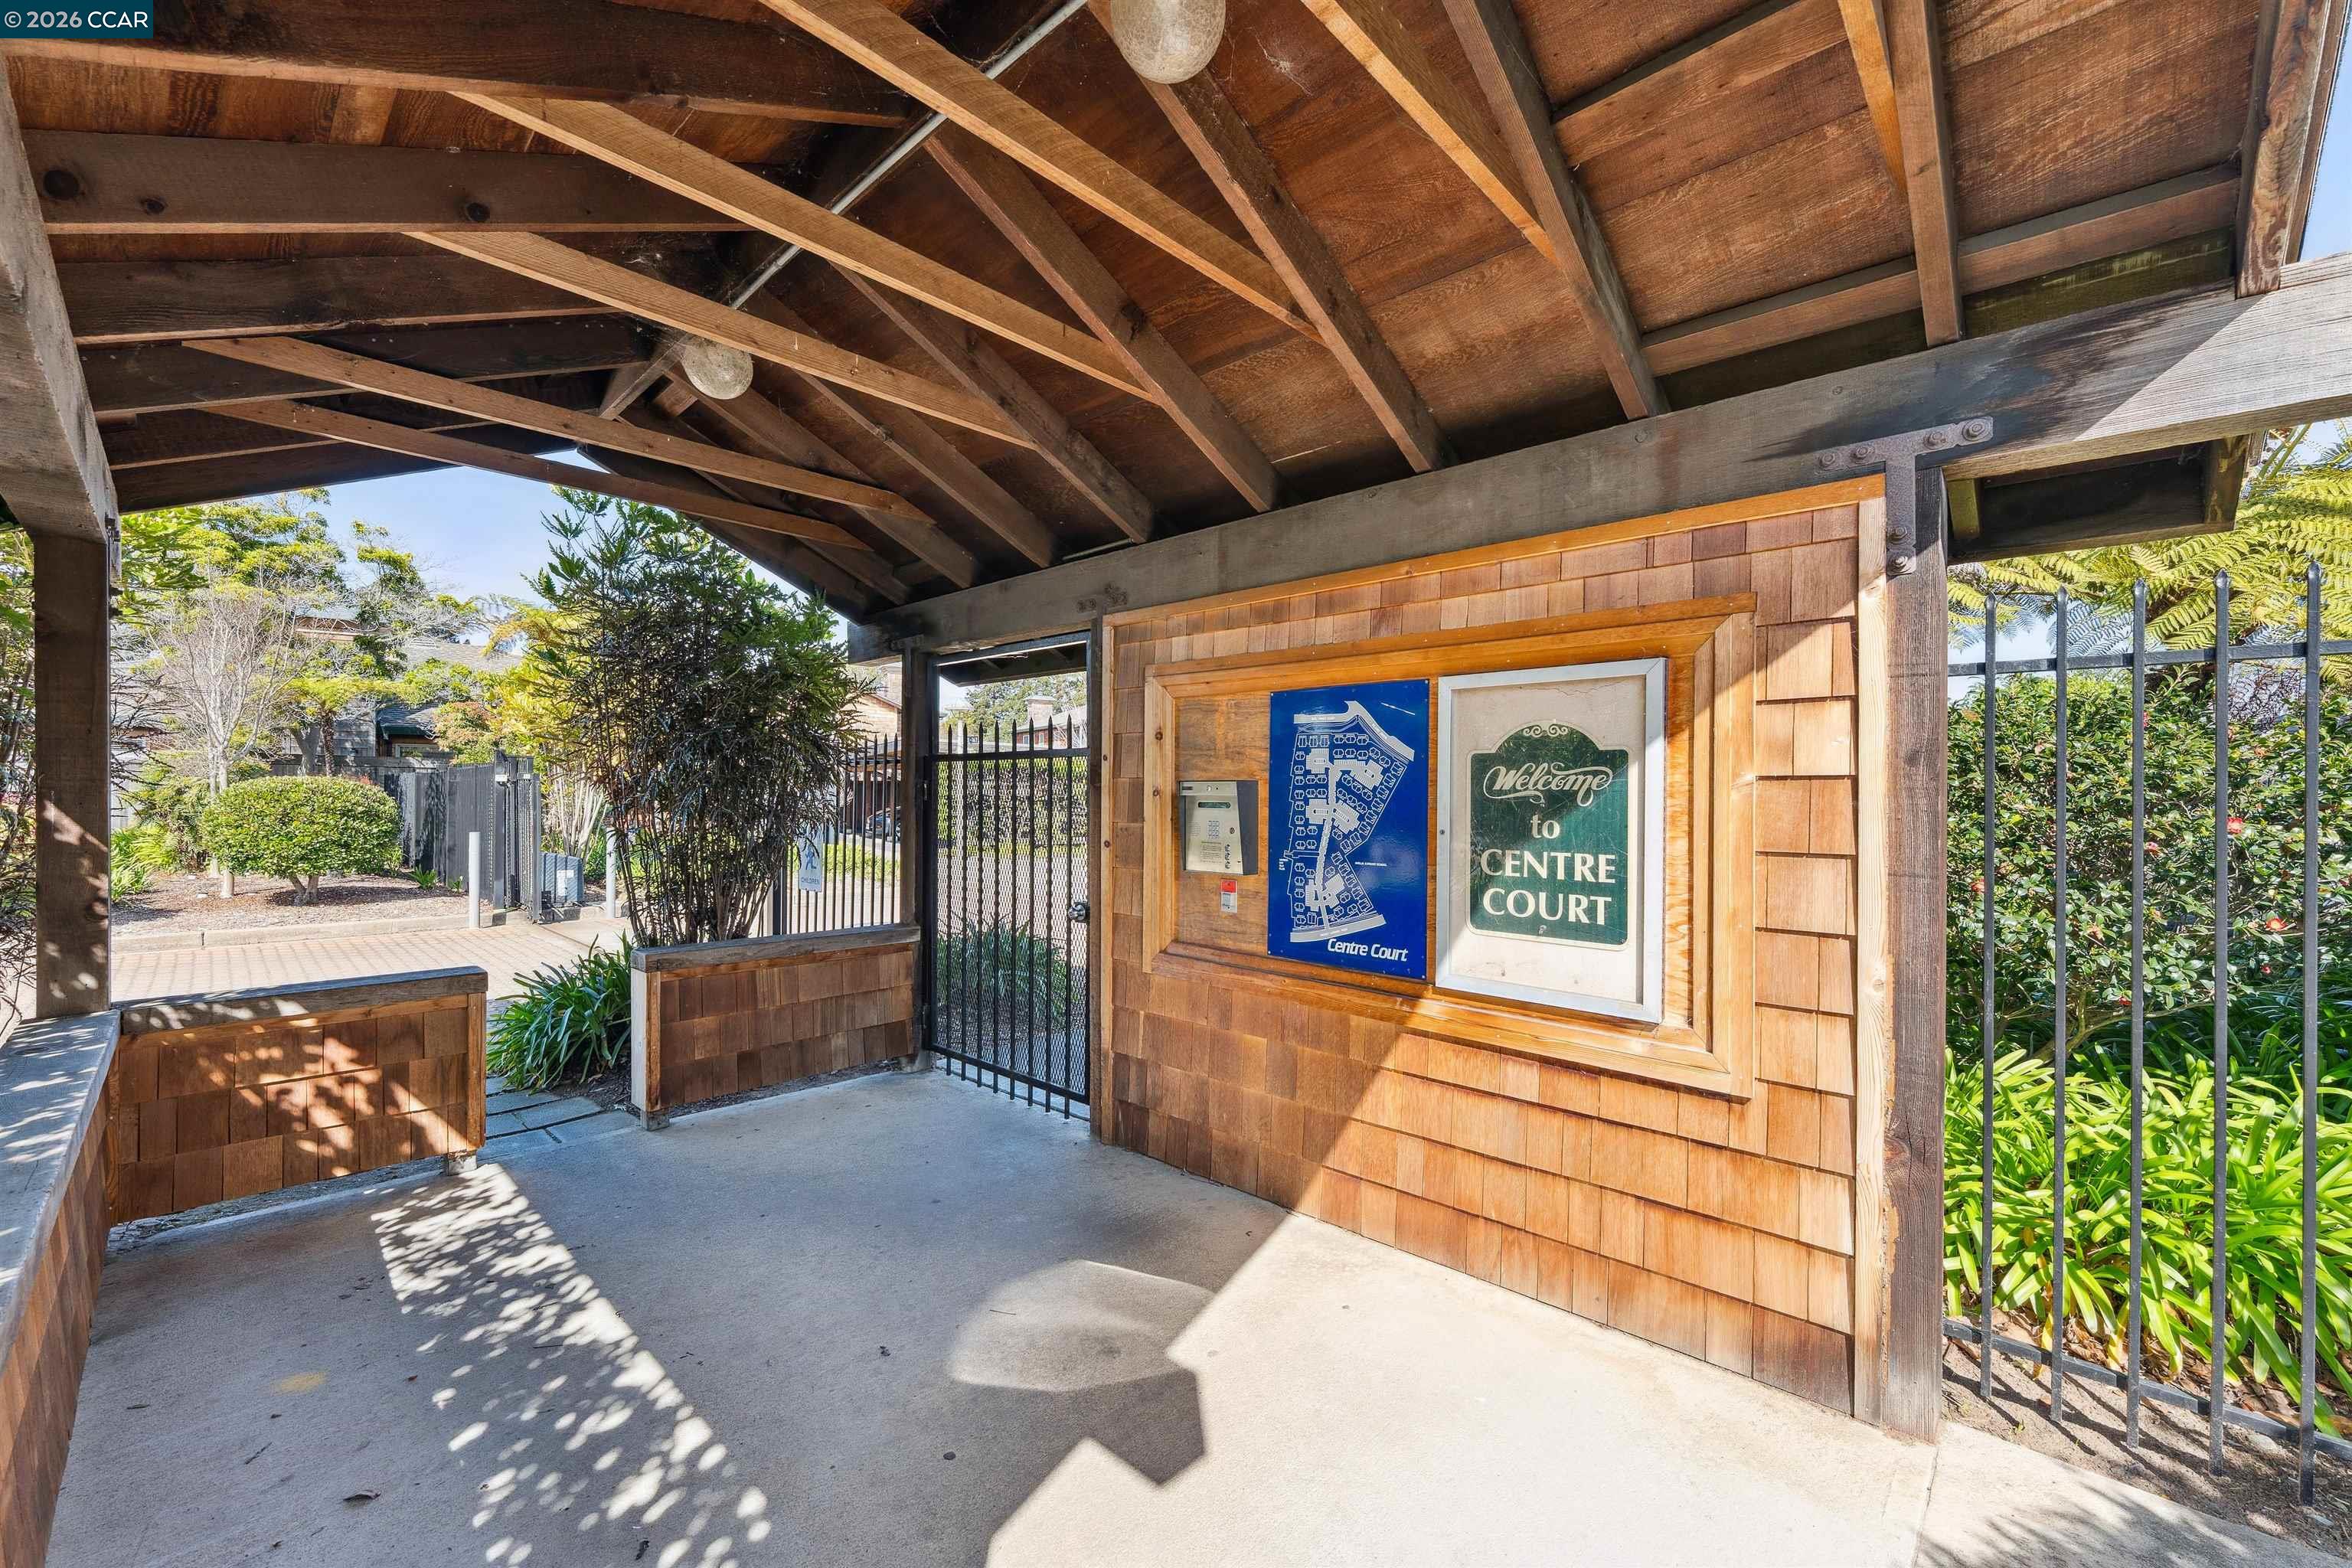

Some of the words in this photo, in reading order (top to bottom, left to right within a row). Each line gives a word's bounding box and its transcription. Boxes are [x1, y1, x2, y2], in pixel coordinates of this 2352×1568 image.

[1483, 763, 1612, 806] Welcome
[1530, 812, 1560, 839] to
[801, 876, 820, 885] CHILDREN
[1481, 848, 1616, 884] CENTRE
[1482, 887, 1612, 926] COURT
[1328, 938, 1368, 956] Centre
[1370, 943, 1409, 962] Court
